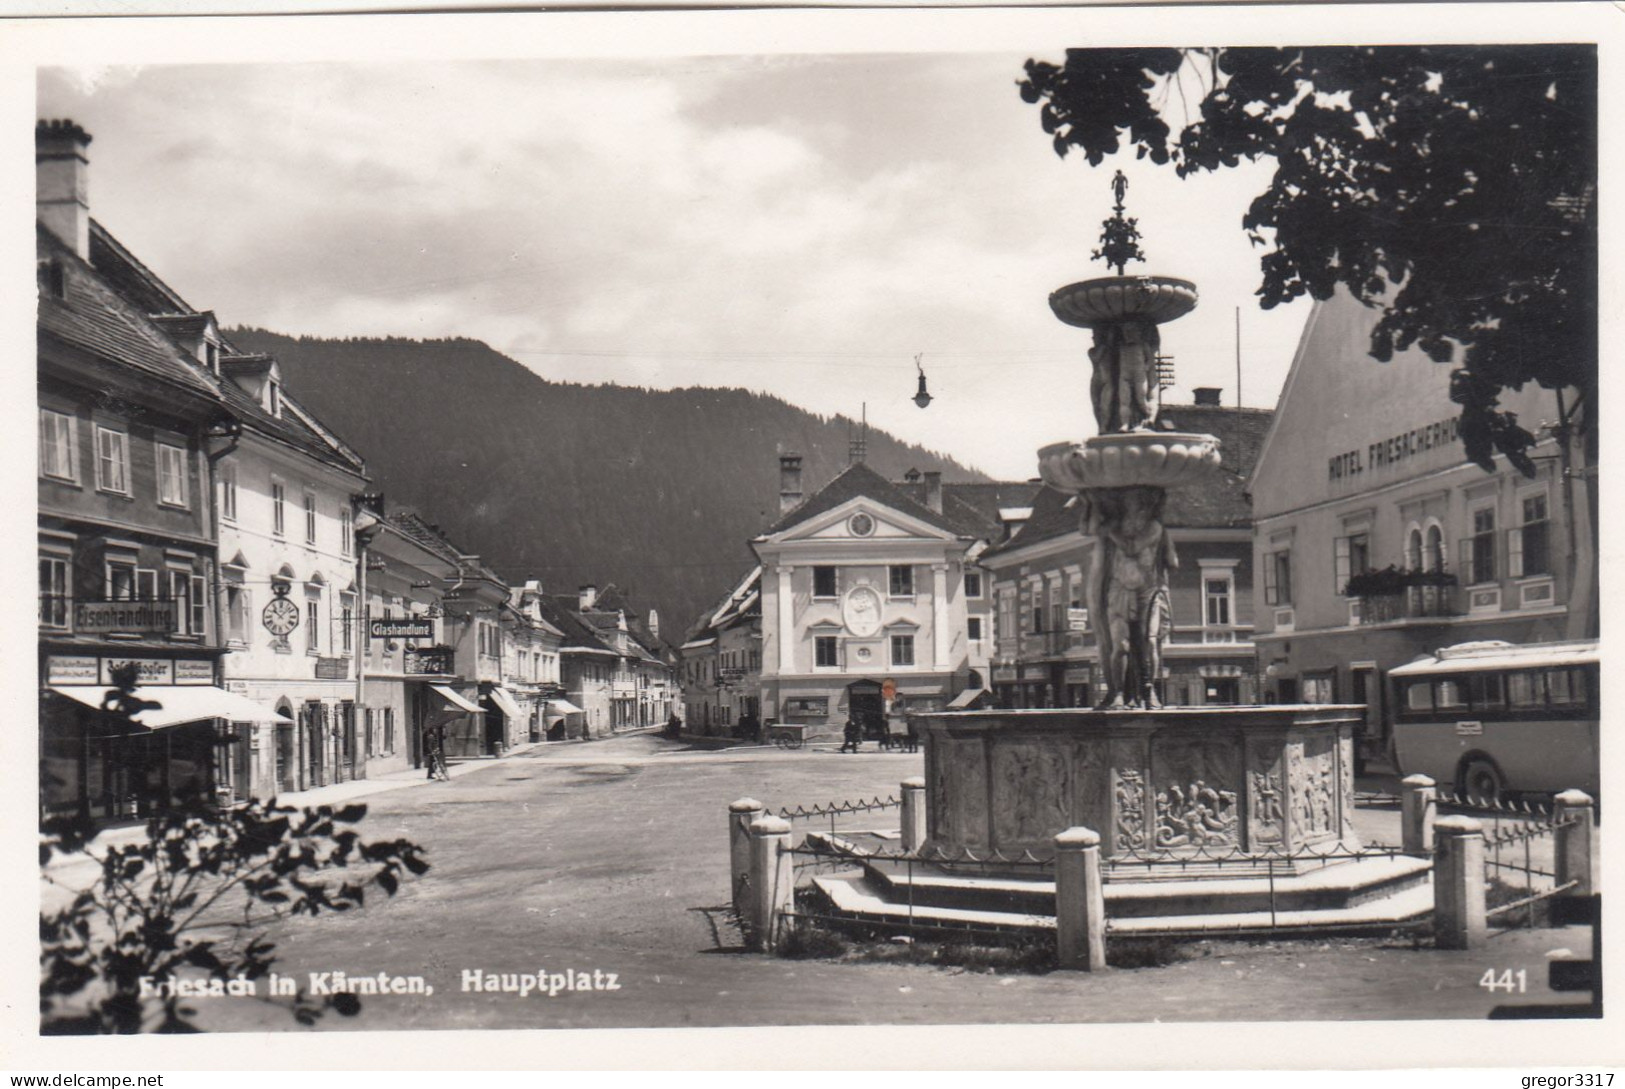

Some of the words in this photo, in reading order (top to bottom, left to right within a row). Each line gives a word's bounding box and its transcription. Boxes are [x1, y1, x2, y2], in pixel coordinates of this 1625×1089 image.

[1328, 449, 1363, 481] HOTEL
[1369, 416, 1459, 470] FRIESACHERHO
[372, 622, 429, 636] Glashandlung
